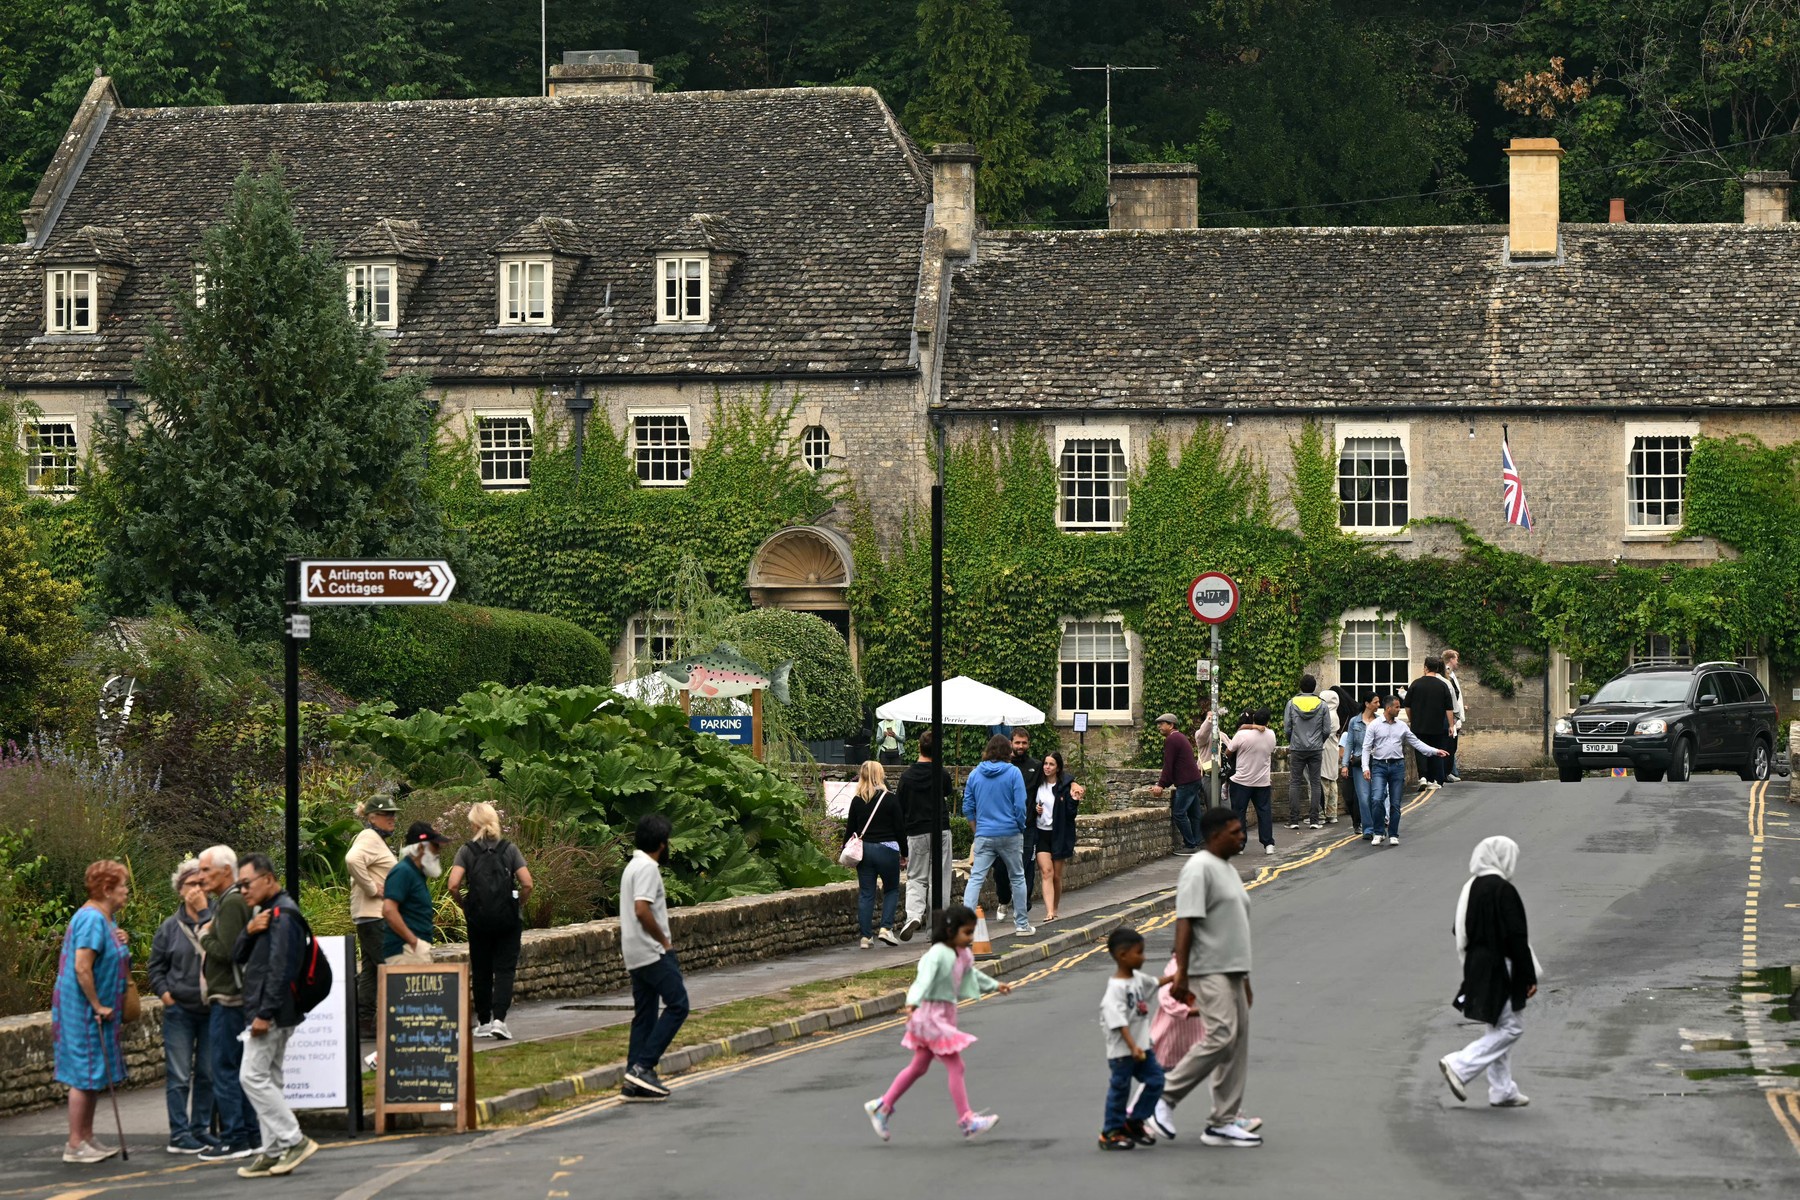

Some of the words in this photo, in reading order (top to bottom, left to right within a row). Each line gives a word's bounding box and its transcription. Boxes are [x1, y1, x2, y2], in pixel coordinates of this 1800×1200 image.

[328, 569, 385, 583] Arlington
[388, 569, 416, 581] Row
[328, 582, 384, 595] Cottages
[1206, 591, 1216, 599] 17
[700, 719, 742, 729] PARKING
[944, 716, 967, 724] Perrier
[405, 974, 444, 992] SPECIALS
[305, 1012, 334, 1020] RDENS
[308, 1026, 332, 1034] GIFTS
[297, 1039, 338, 1047] COUNTER
[283, 1054, 306, 1062] OWN
[284, 1082, 310, 1090] 40215
